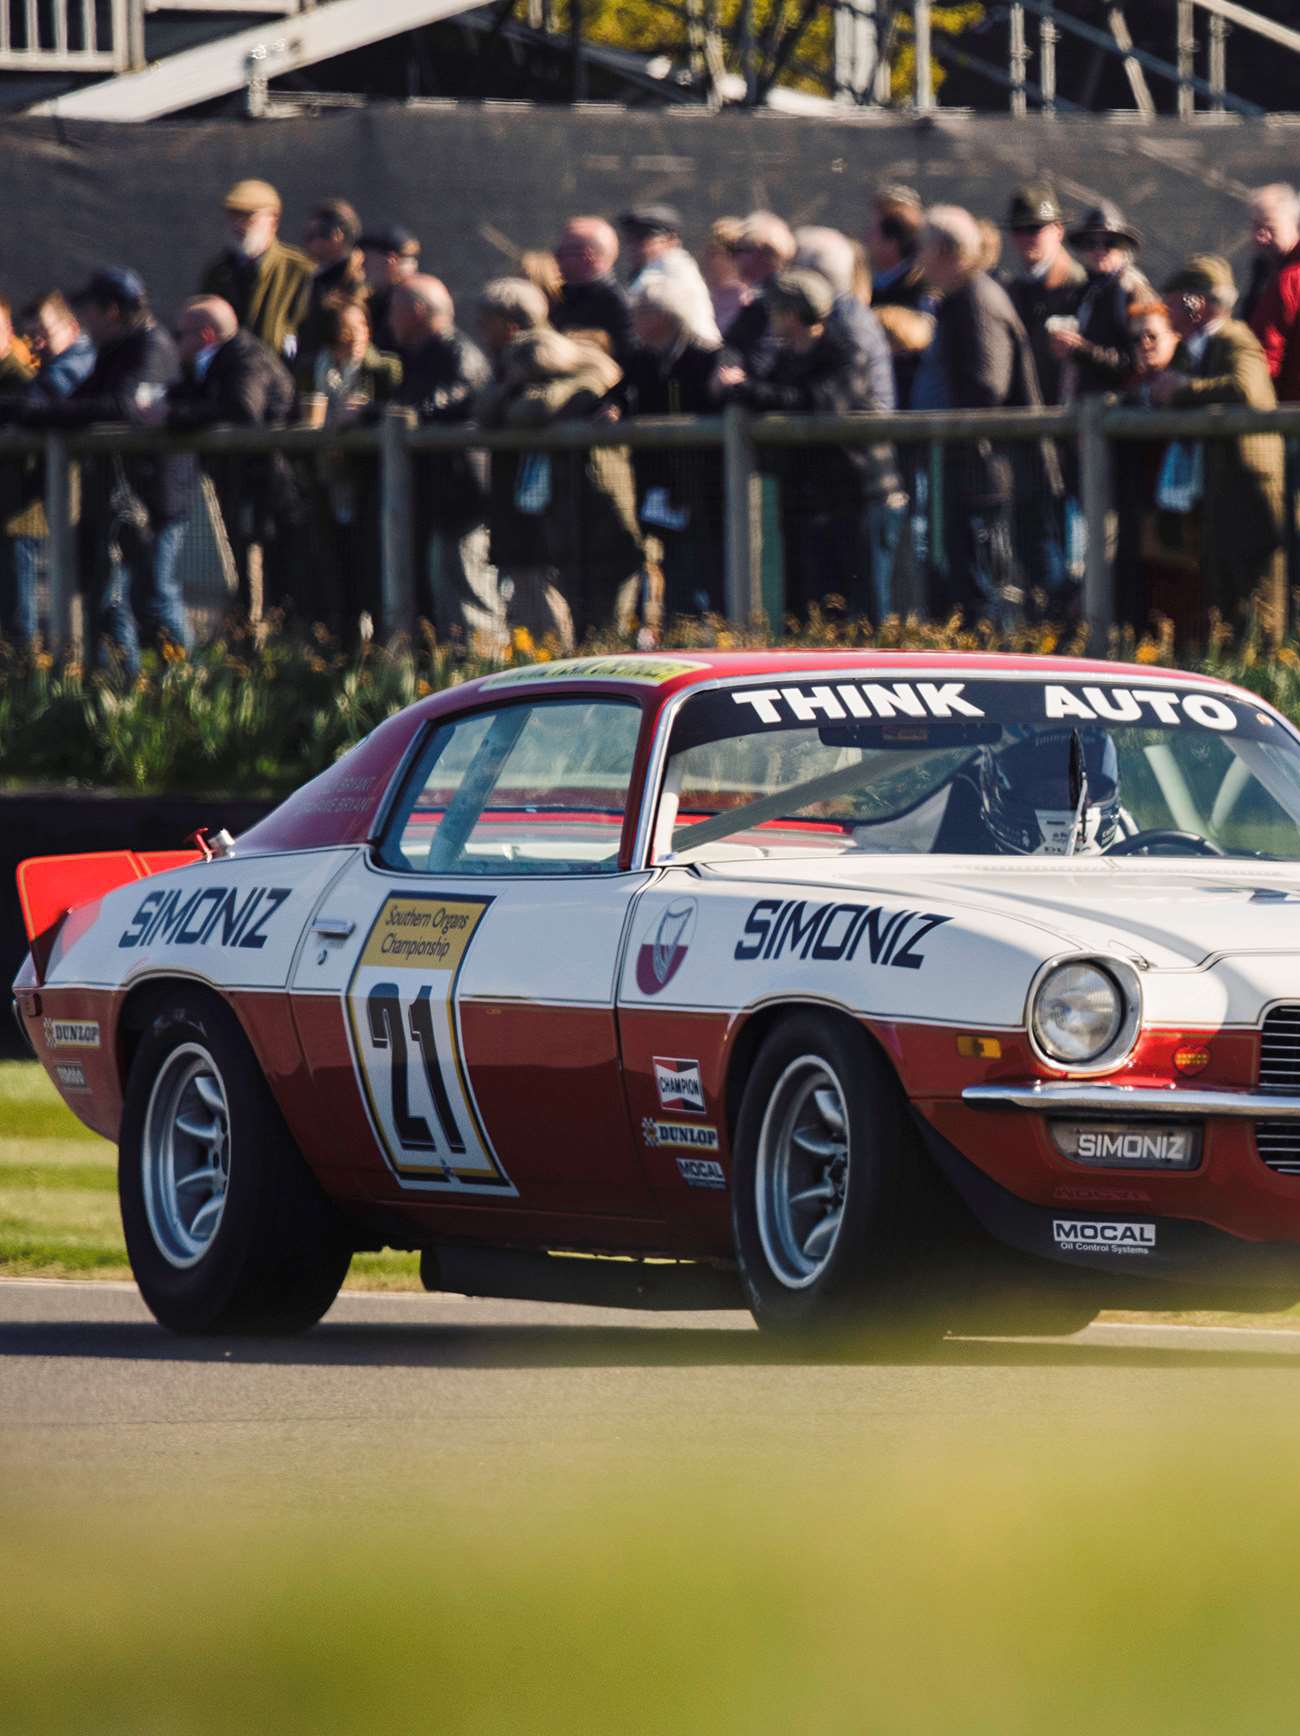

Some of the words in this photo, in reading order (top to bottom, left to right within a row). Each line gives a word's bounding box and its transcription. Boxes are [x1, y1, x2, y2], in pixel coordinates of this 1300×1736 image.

[731, 683, 985, 724] THINK
[1045, 685, 1238, 731] AUTO
[118, 886, 293, 949] SIMONIZ
[385, 905, 432, 927] Southern
[432, 907, 470, 934] Organs
[381, 932, 451, 961] Championship
[734, 899, 955, 970] SIMONIZ
[55, 1024, 99, 1041] DUNLOP
[367, 982, 467, 1154] 21
[660, 1076, 700, 1095] CHAMPION
[659, 1126, 717, 1145] DUNLOP
[1078, 1133, 1186, 1160] SIMONIZ
[680, 1162, 723, 1178] MOCAL
[1055, 1223, 1153, 1242] MOCAL
[1060, 1242, 1074, 1250] Oil
[1075, 1242, 1109, 1252] Control
[1111, 1244, 1149, 1255] Systems
